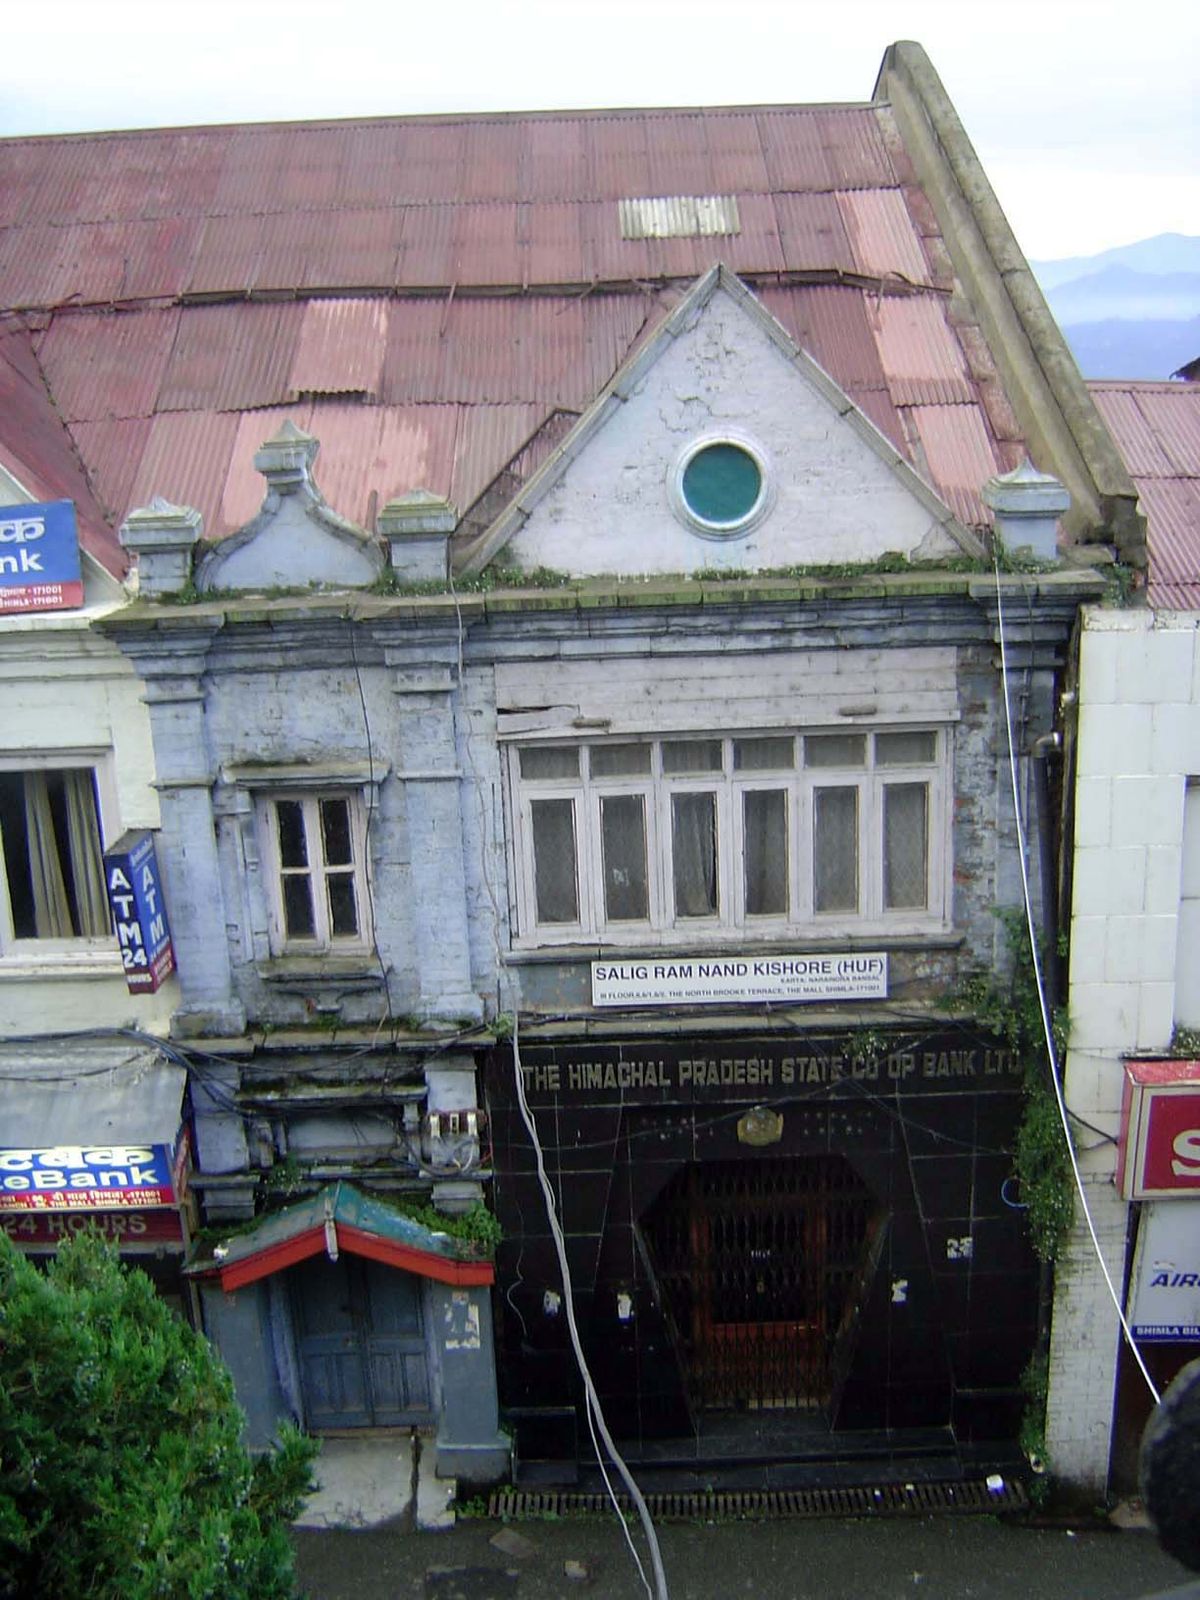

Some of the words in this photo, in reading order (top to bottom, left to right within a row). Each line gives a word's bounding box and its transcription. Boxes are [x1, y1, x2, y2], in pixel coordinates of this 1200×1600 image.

[110, 868, 143, 946] ATM
[142, 864, 165, 944] ATM
[122, 948, 148, 968] 24
[596, 967, 648, 980] SALIG
[654, 965, 693, 979] RAM
[698, 963, 748, 978] NAND
[753, 960, 831, 976] KISHORE
[837, 958, 884, 977] (HUF)
[522, 1065, 561, 1092] THE
[568, 1060, 671, 1090] HIMACHAL
[678, 1058, 774, 1087] PRADESH
[781, 1056, 844, 1084] STATE
[923, 1050, 978, 1078] BANK
[3, 1214, 38, 1234] 24
[47, 1214, 147, 1234] HOURS
[1150, 1273, 1200, 1287] AIR
